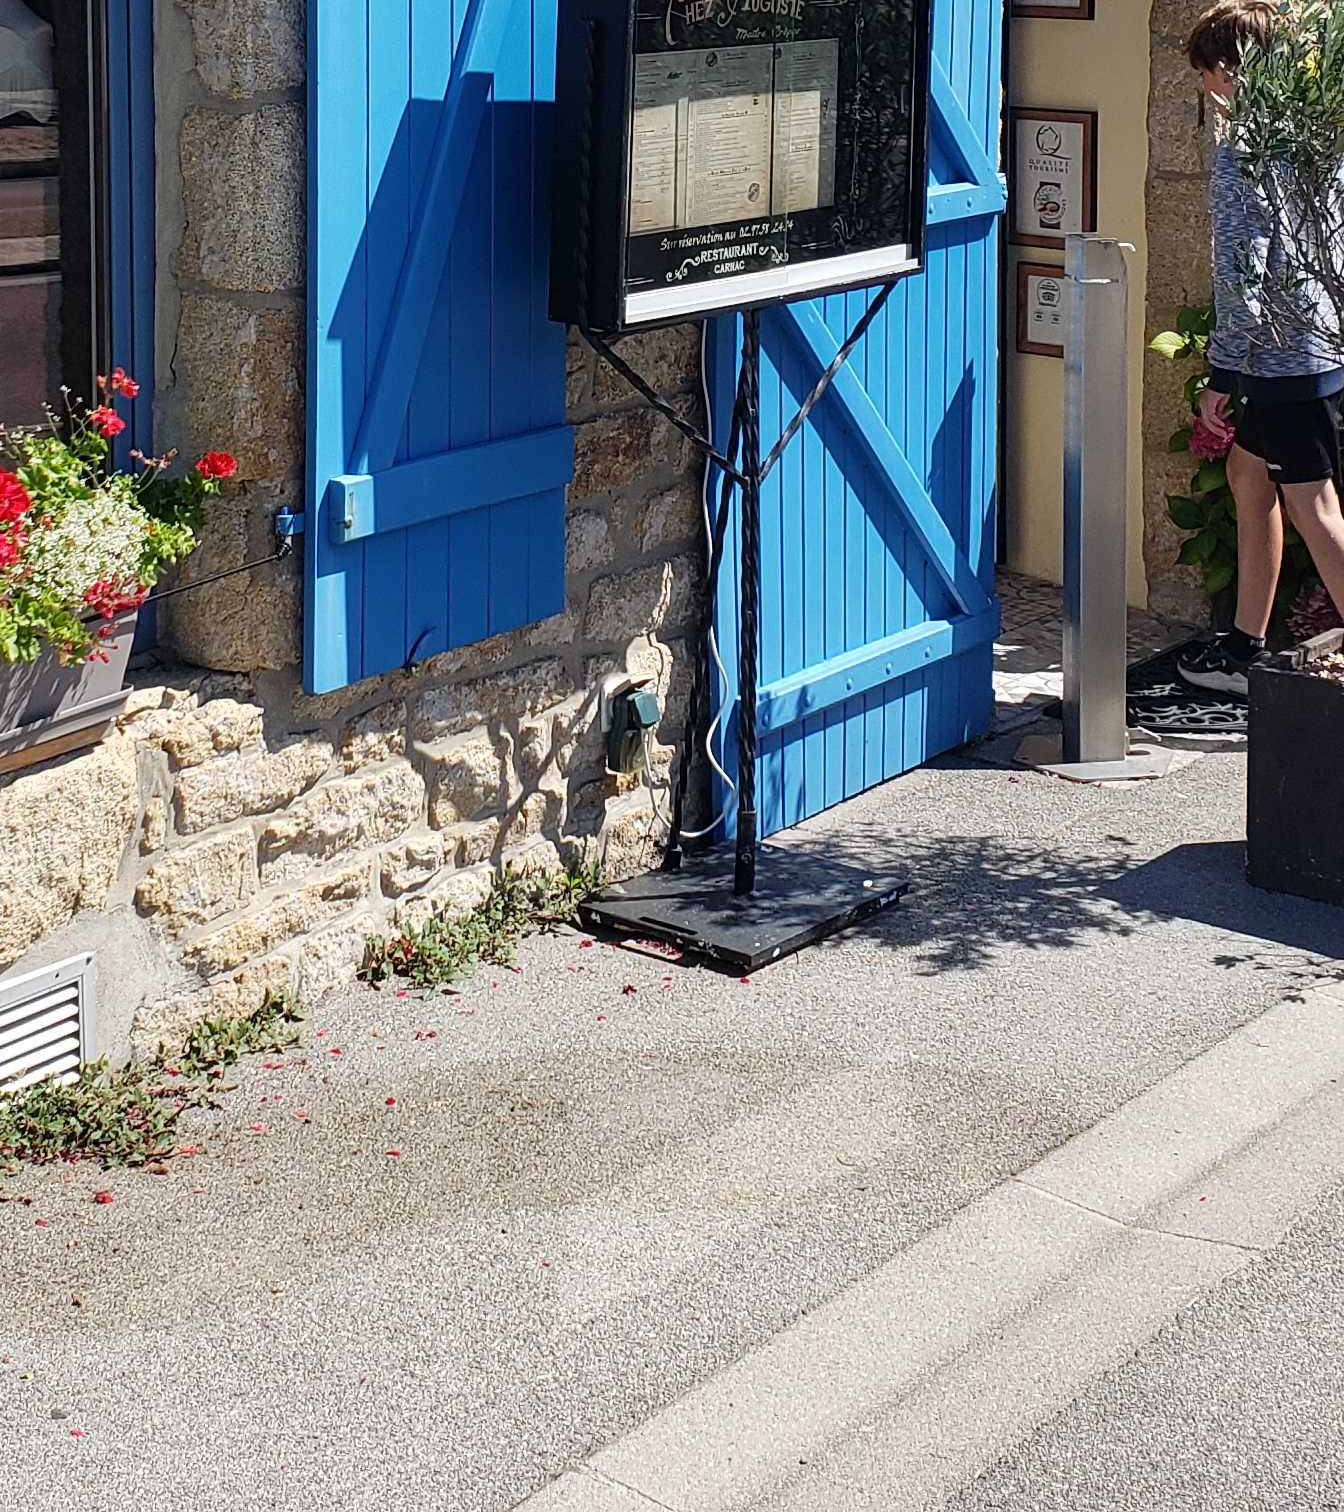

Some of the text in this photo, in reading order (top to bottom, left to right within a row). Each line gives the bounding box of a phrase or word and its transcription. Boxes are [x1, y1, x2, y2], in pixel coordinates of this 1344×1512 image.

[660, 237, 678, 251] Sur
[678, 231, 724, 249] réservation
[724, 230, 736, 241] au
[700, 242, 759, 264] RESTAURANT
[714, 260, 746, 275] CARNAC
